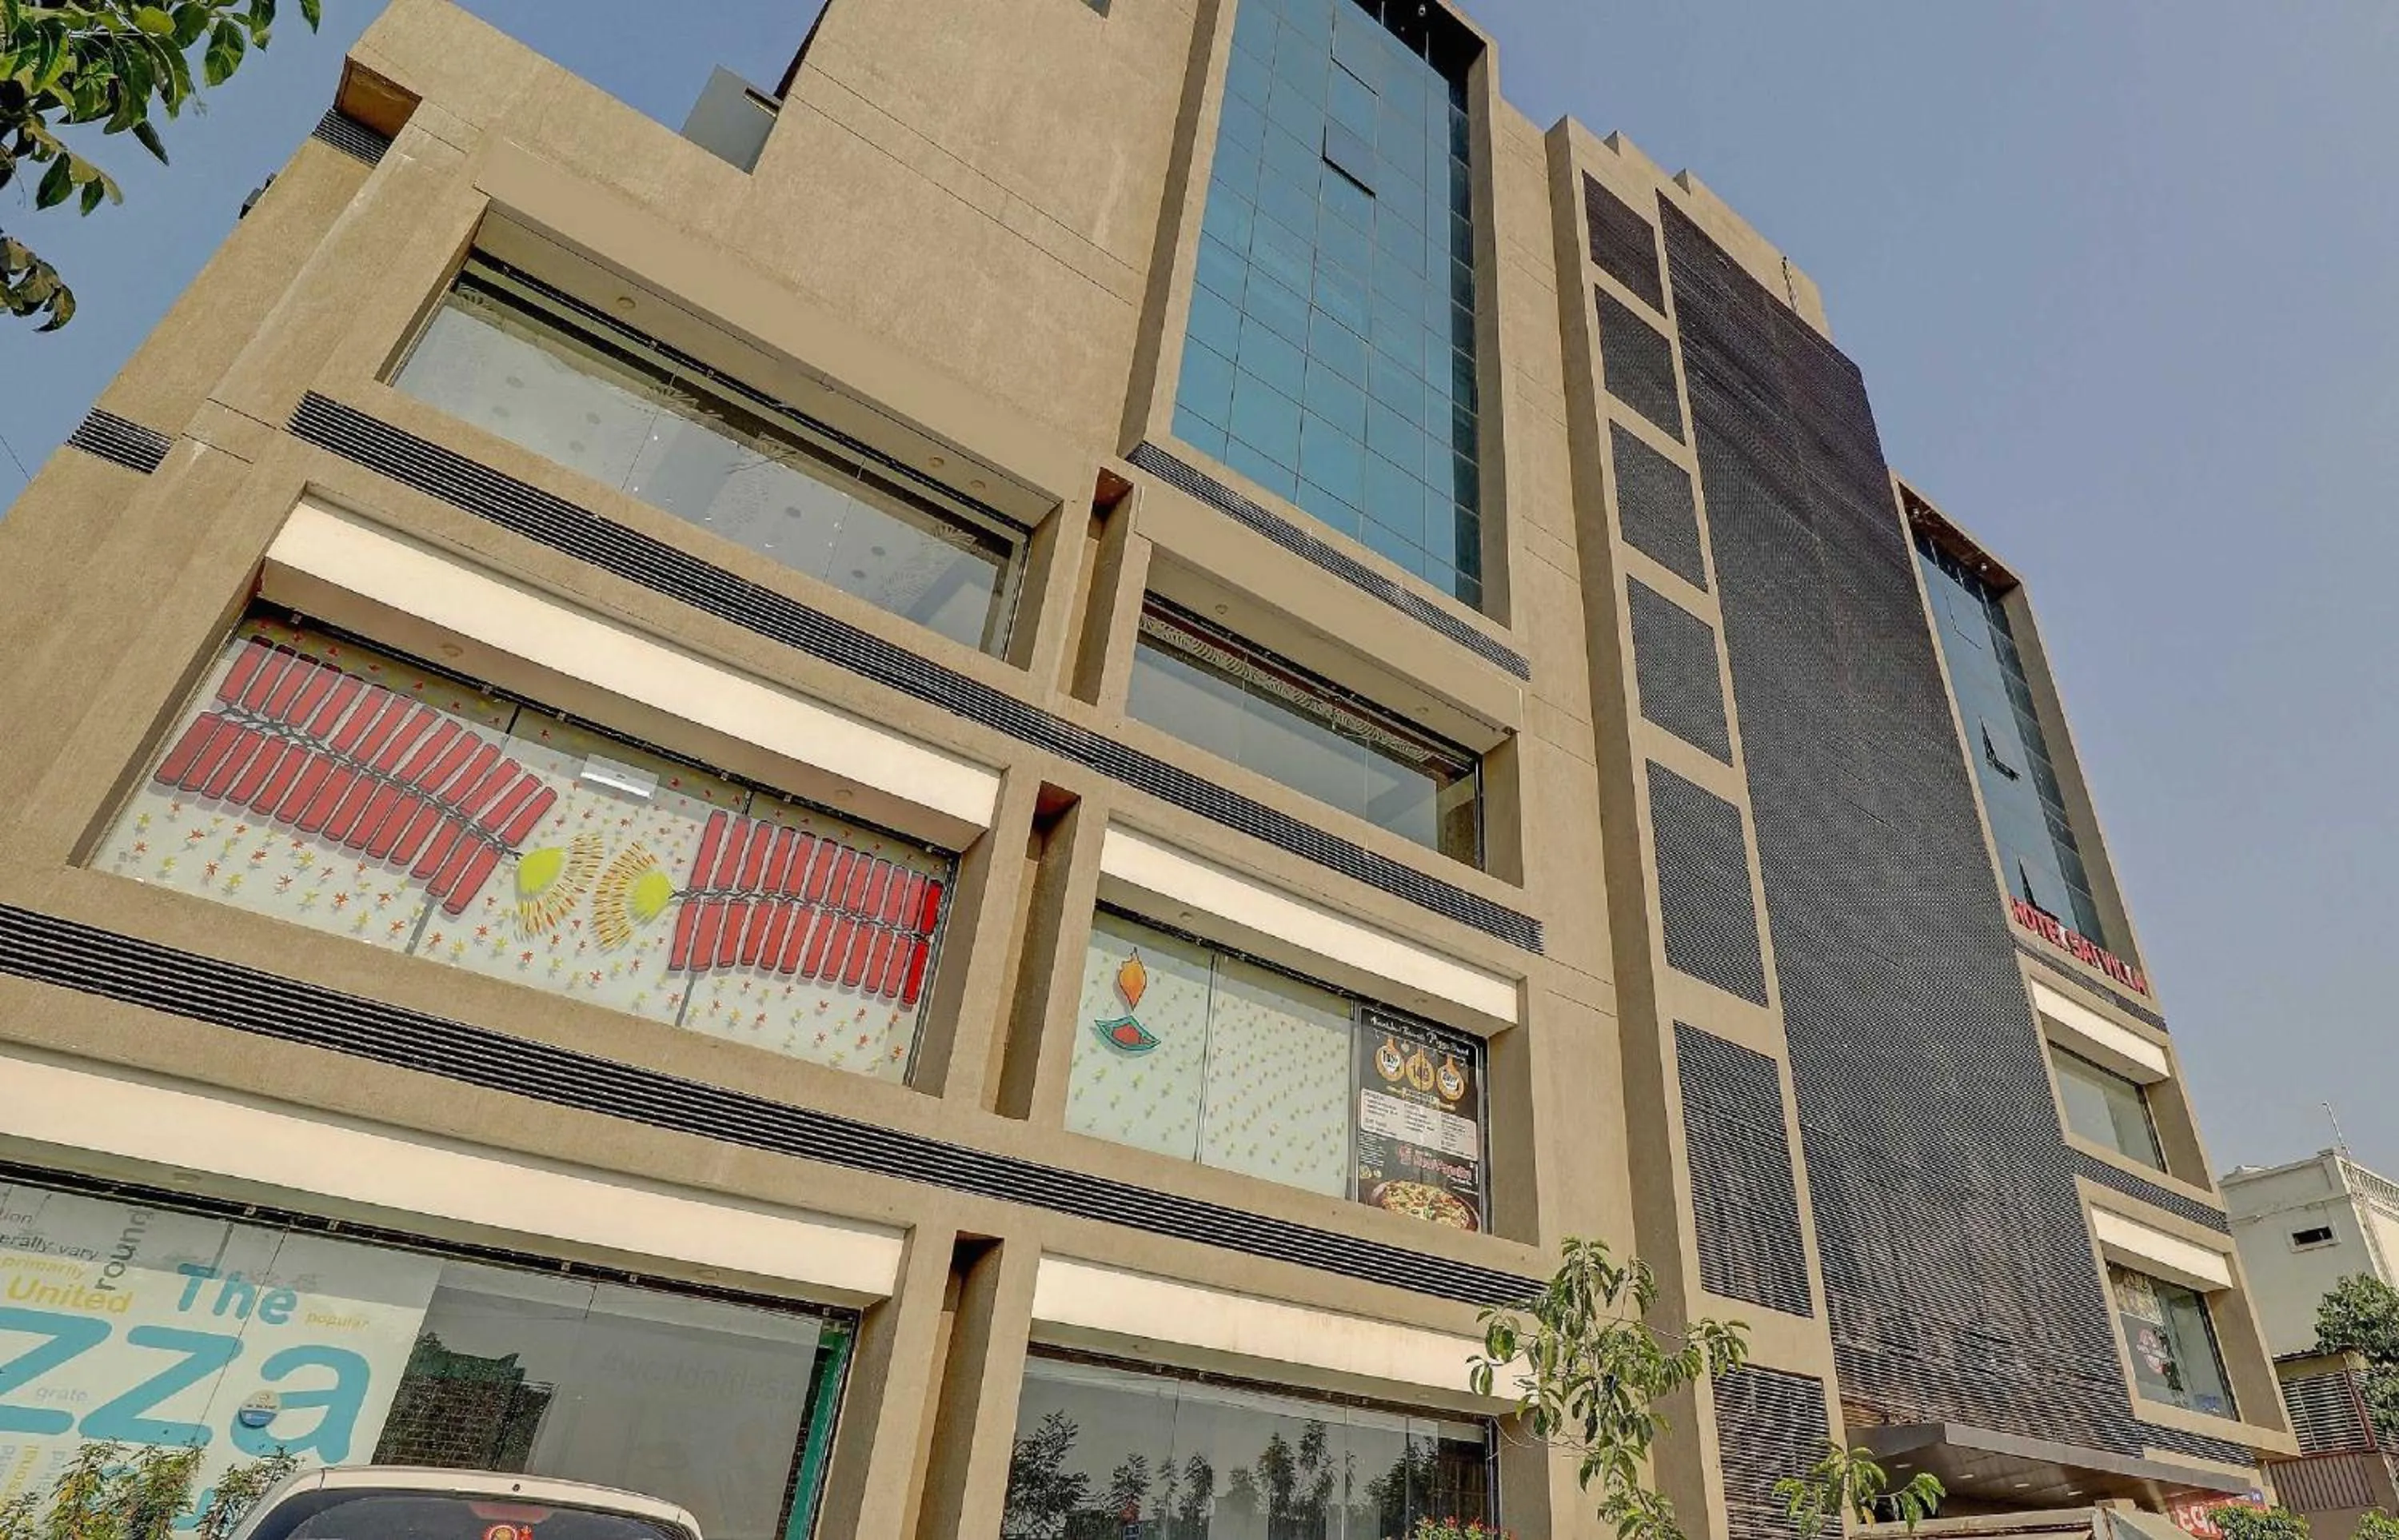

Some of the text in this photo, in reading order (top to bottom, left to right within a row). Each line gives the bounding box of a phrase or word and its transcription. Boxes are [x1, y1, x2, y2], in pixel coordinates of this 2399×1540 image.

[2008, 895, 2071, 956] HOTEL
[0, 1256, 85, 1280] primarily
[59, 1243, 99, 1262] vary
[7, 1275, 134, 1314] United
[176, 1262, 298, 1325] The
[305, 1311, 371, 1332] popular
